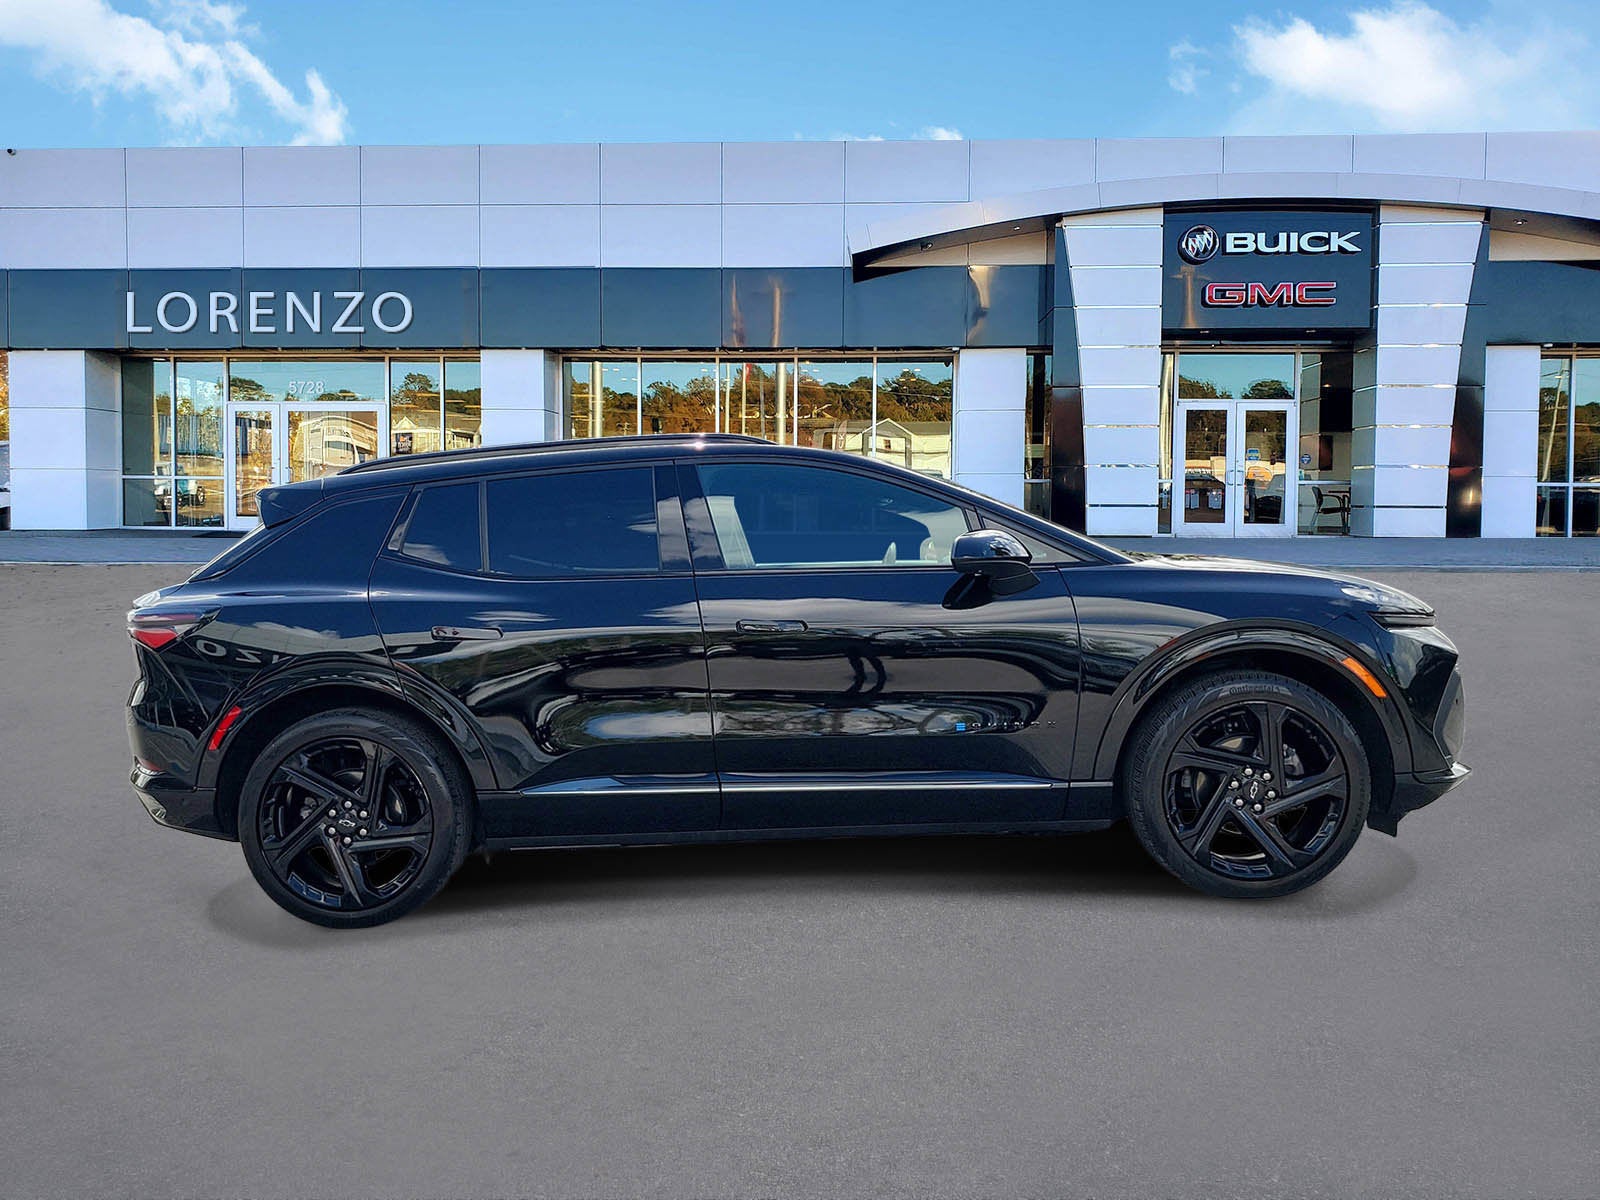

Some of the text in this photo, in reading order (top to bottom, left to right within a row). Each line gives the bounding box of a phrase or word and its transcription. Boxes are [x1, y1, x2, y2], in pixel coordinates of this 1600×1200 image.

[1225, 231, 1362, 253] BUICK
[1205, 281, 1338, 305] GMC
[126, 291, 413, 333] LORENZO
[288, 381, 326, 395] 5728
